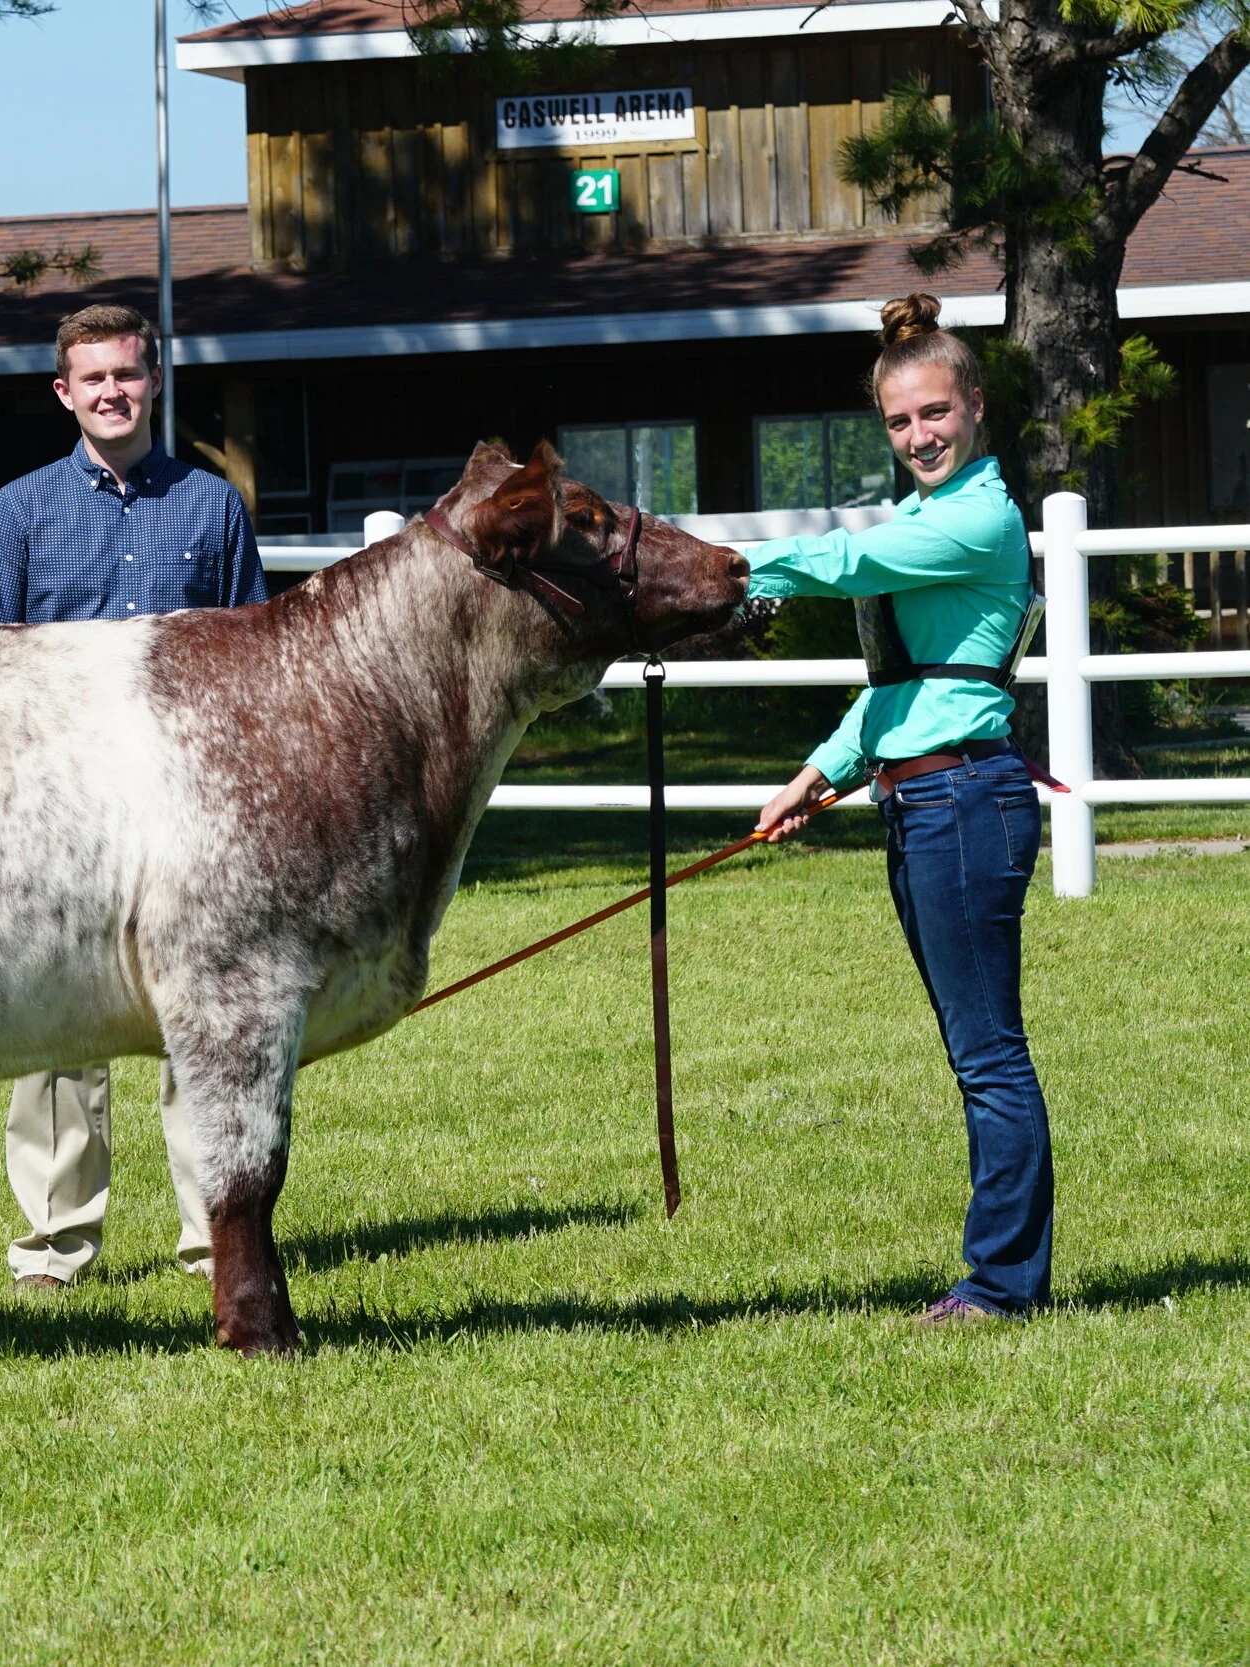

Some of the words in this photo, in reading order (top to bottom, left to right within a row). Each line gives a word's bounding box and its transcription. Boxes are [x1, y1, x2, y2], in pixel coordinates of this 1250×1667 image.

[504, 97, 605, 129] CASWELL
[615, 91, 686, 122] ARENA
[575, 128, 617, 141] 1999
[576, 174, 613, 206] 21
